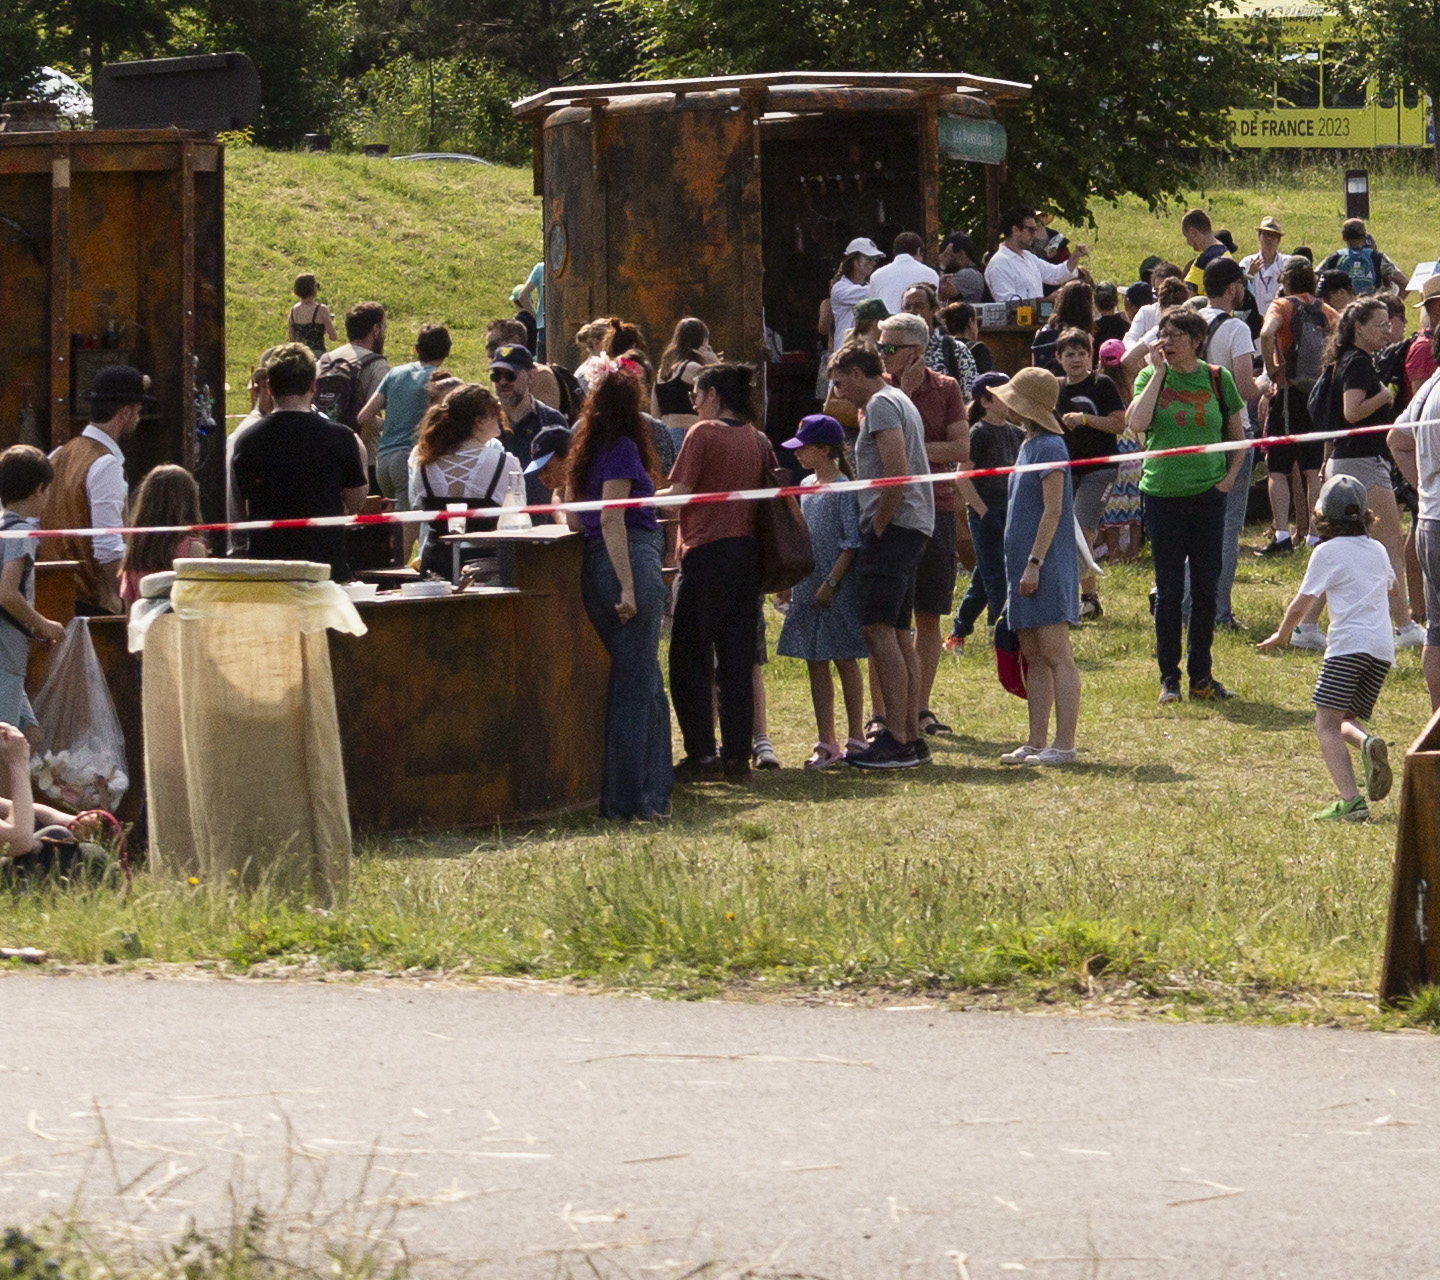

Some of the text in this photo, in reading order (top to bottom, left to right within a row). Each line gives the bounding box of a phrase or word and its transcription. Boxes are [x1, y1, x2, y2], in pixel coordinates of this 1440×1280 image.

[1240, 119, 1258, 137] DE
[1261, 119, 1315, 137] FRANCE
[1317, 117, 1351, 137] 2023
